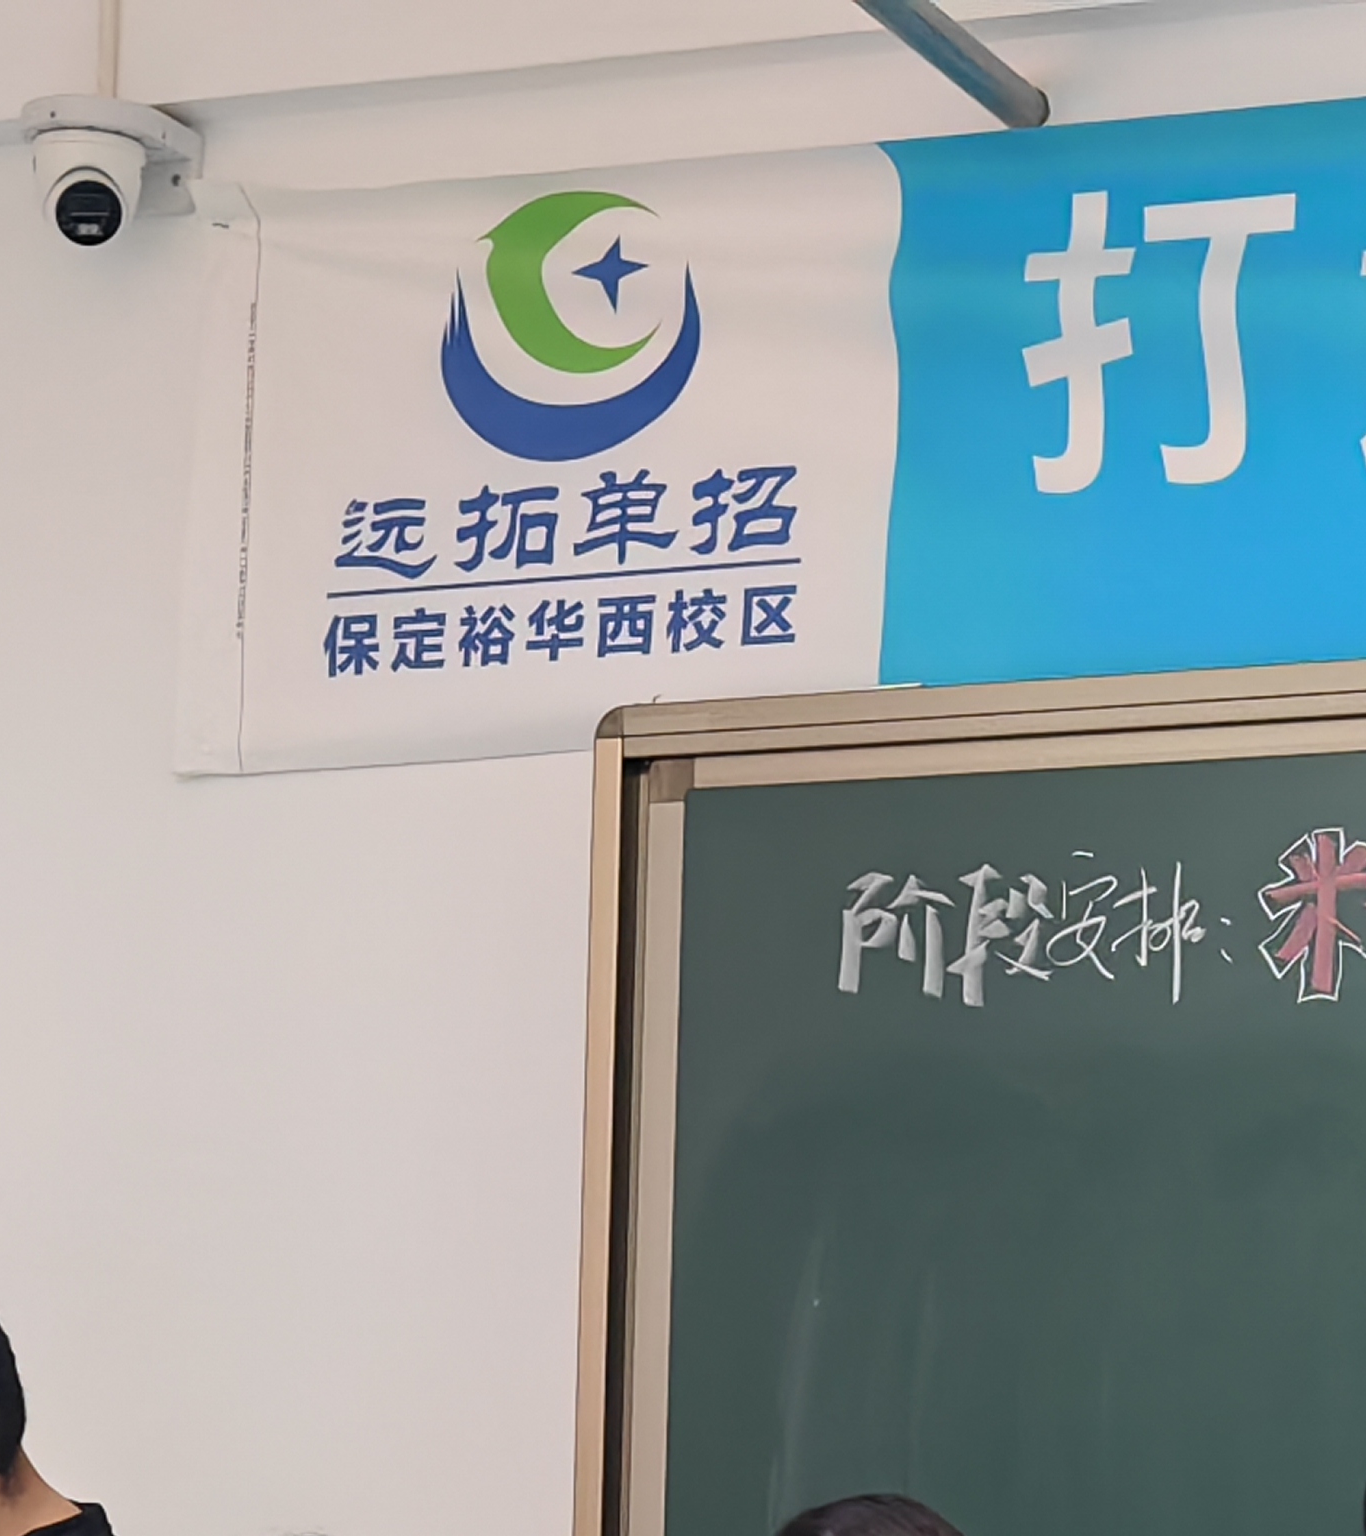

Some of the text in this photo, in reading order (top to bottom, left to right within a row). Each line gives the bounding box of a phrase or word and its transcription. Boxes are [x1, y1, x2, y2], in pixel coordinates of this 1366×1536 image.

[335, 464, 800, 580] 远拓单招
[323, 585, 798, 678] 保定裕华西校区
